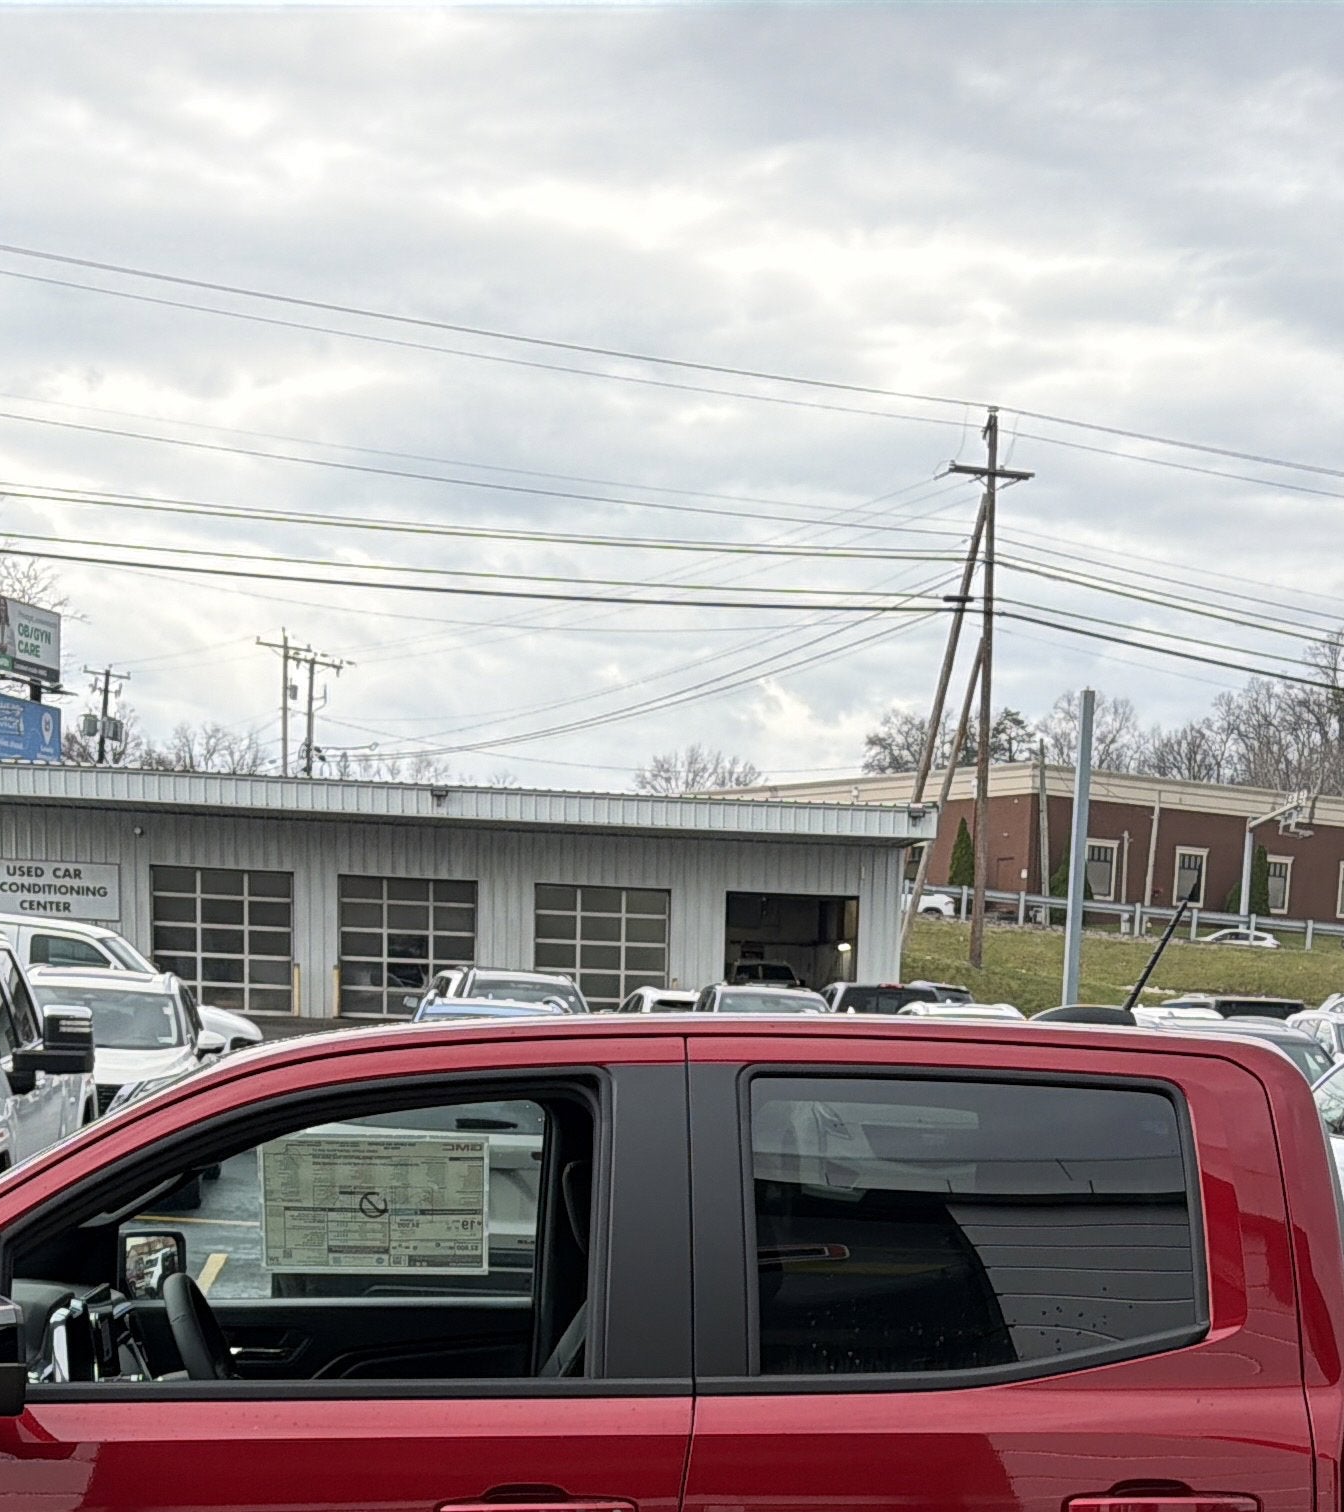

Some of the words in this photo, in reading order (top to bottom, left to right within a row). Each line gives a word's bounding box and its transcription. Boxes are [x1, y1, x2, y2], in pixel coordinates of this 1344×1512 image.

[17, 622, 52, 645] OB/GYN
[17, 640, 40, 659] CARE
[6, 865, 45, 878] USED
[52, 868, 83, 880] CAR
[19, 899, 72, 913] CENTER
